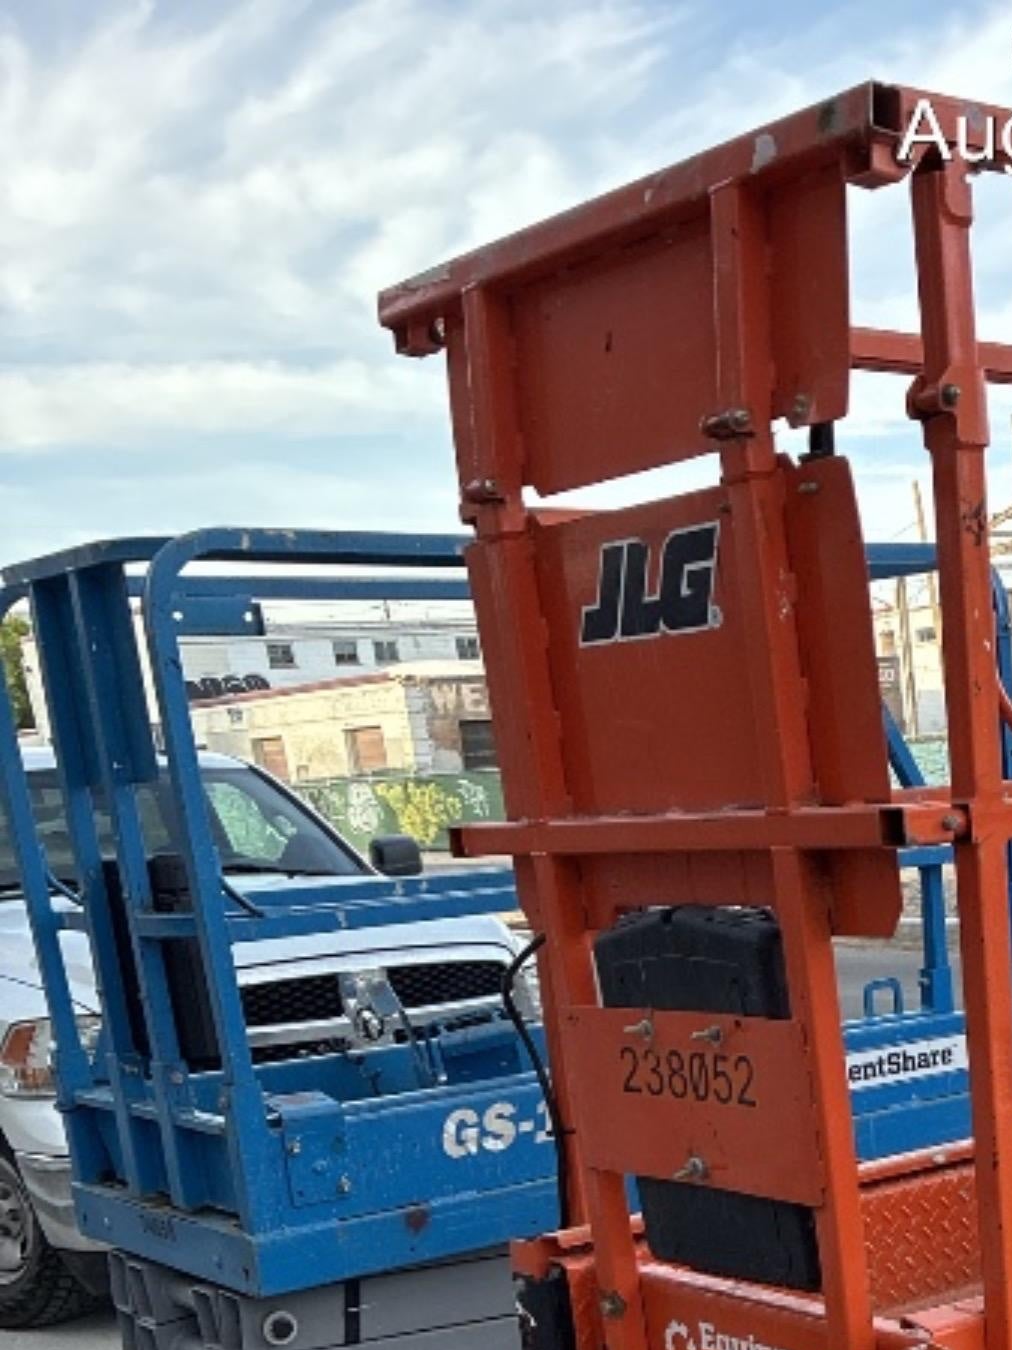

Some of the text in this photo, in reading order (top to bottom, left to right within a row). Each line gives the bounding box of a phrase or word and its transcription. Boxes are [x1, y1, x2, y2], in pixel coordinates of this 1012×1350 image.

[579, 520, 722, 648] JLG
[430, 682, 489, 715] WE
[620, 1046, 757, 1108] 238052
[849, 1046, 954, 1082] entShare
[442, 1101, 555, 1159] GS-1
